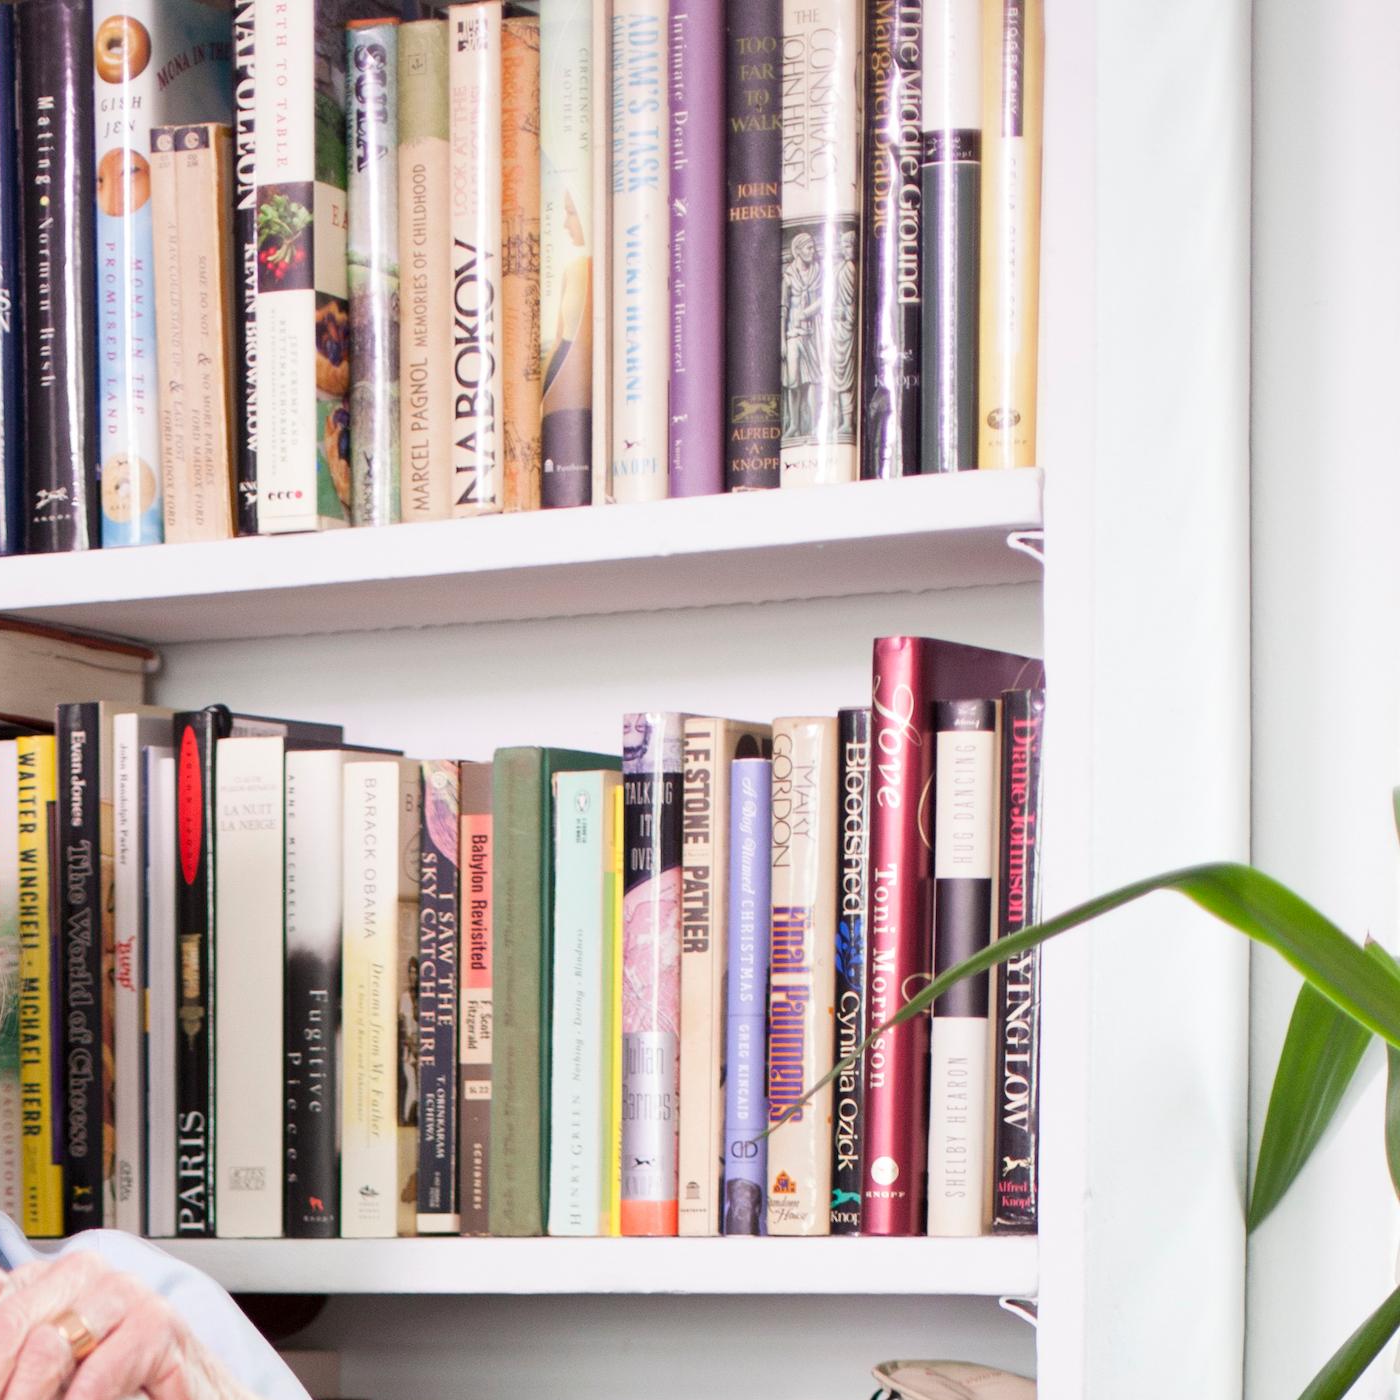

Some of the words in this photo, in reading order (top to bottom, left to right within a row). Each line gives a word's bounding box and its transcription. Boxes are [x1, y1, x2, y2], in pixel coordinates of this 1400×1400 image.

[627, 14, 660, 113] ADAM'S
[673, 13, 689, 100] Intimate
[737, 37, 777, 55] TOO
[783, 34, 806, 99] JOHN
[898, 4, 922, 62] The
[234, 0, 258, 211] NAPOLEON
[354, 42, 388, 173] SULA
[738, 65, 774, 81] FAR
[35, 95, 54, 186] Mating
[673, 111, 689, 170] Death
[731, 116, 781, 132] WALK
[783, 104, 807, 190] HERSEY
[898, 69, 922, 176] Middle
[628, 126, 660, 193] TASK
[738, 183, 778, 198] JOHN
[412, 164, 426, 246] CHILDHOOD
[730, 206, 782, 221] HERSEY
[37, 217, 54, 311] Norman
[242, 240, 257, 314] KEVIN
[413, 250, 426, 269] OF
[674, 229, 687, 272] Marie
[898, 184, 922, 304] Ground
[413, 274, 427, 347] MEMORIES
[675, 280, 687, 297] de
[38, 328, 56, 388] Rush
[243, 316, 258, 453] BROWNLOW
[453, 238, 495, 508] NABOKOV
[411, 358, 428, 432] PAGNOL
[733, 427, 780, 441] ALFRED
[733, 457, 780, 472] KNOPF
[411, 439, 429, 510] MARCEL
[69, 731, 86, 775] Evan
[872, 674, 922, 809] Love
[1010, 715, 1037, 805] Diane
[19, 752, 37, 833] WALTER
[69, 776, 87, 827] Jones
[287, 775, 295, 818] ANNE
[362, 778, 378, 860] BARACK
[640, 813, 653, 837] IT
[683, 768, 710, 844] STONE
[772, 733, 793, 867] GORDON
[792, 763, 817, 841] MARY
[842, 741, 867, 915] Bloodshed
[19, 848, 39, 949] WINCHELL
[288, 838, 296, 932] MICHAELS
[421, 852, 437, 894] SKY
[467, 834, 489, 893] Babylon
[873, 864, 899, 936] Toni
[1008, 806, 1037, 923] Johnson
[362, 867, 378, 939] OBAMA
[438, 911, 454, 966] SAW
[468, 900, 489, 970] Revisited
[683, 866, 709, 954] PATNER
[420, 908, 436, 1002] CATCH
[21, 978, 40, 1066] MICHAEL
[438, 973, 454, 1027] THE
[466, 1000, 480, 1050] Fitzgerald
[479, 1012, 492, 1040] Scott
[869, 947, 897, 1090] Morrison
[303, 989, 329, 1112] Fugitive
[419, 1011, 436, 1067] FIRE
[737, 1023, 750, 1059] GREG
[836, 990, 860, 1093] Cynthia
[22, 1083, 41, 1137] HERR
[736, 1062, 750, 1120] KINCAID
[179, 1111, 205, 1232] PARIS
[835, 1098, 859, 1172] Ozick
